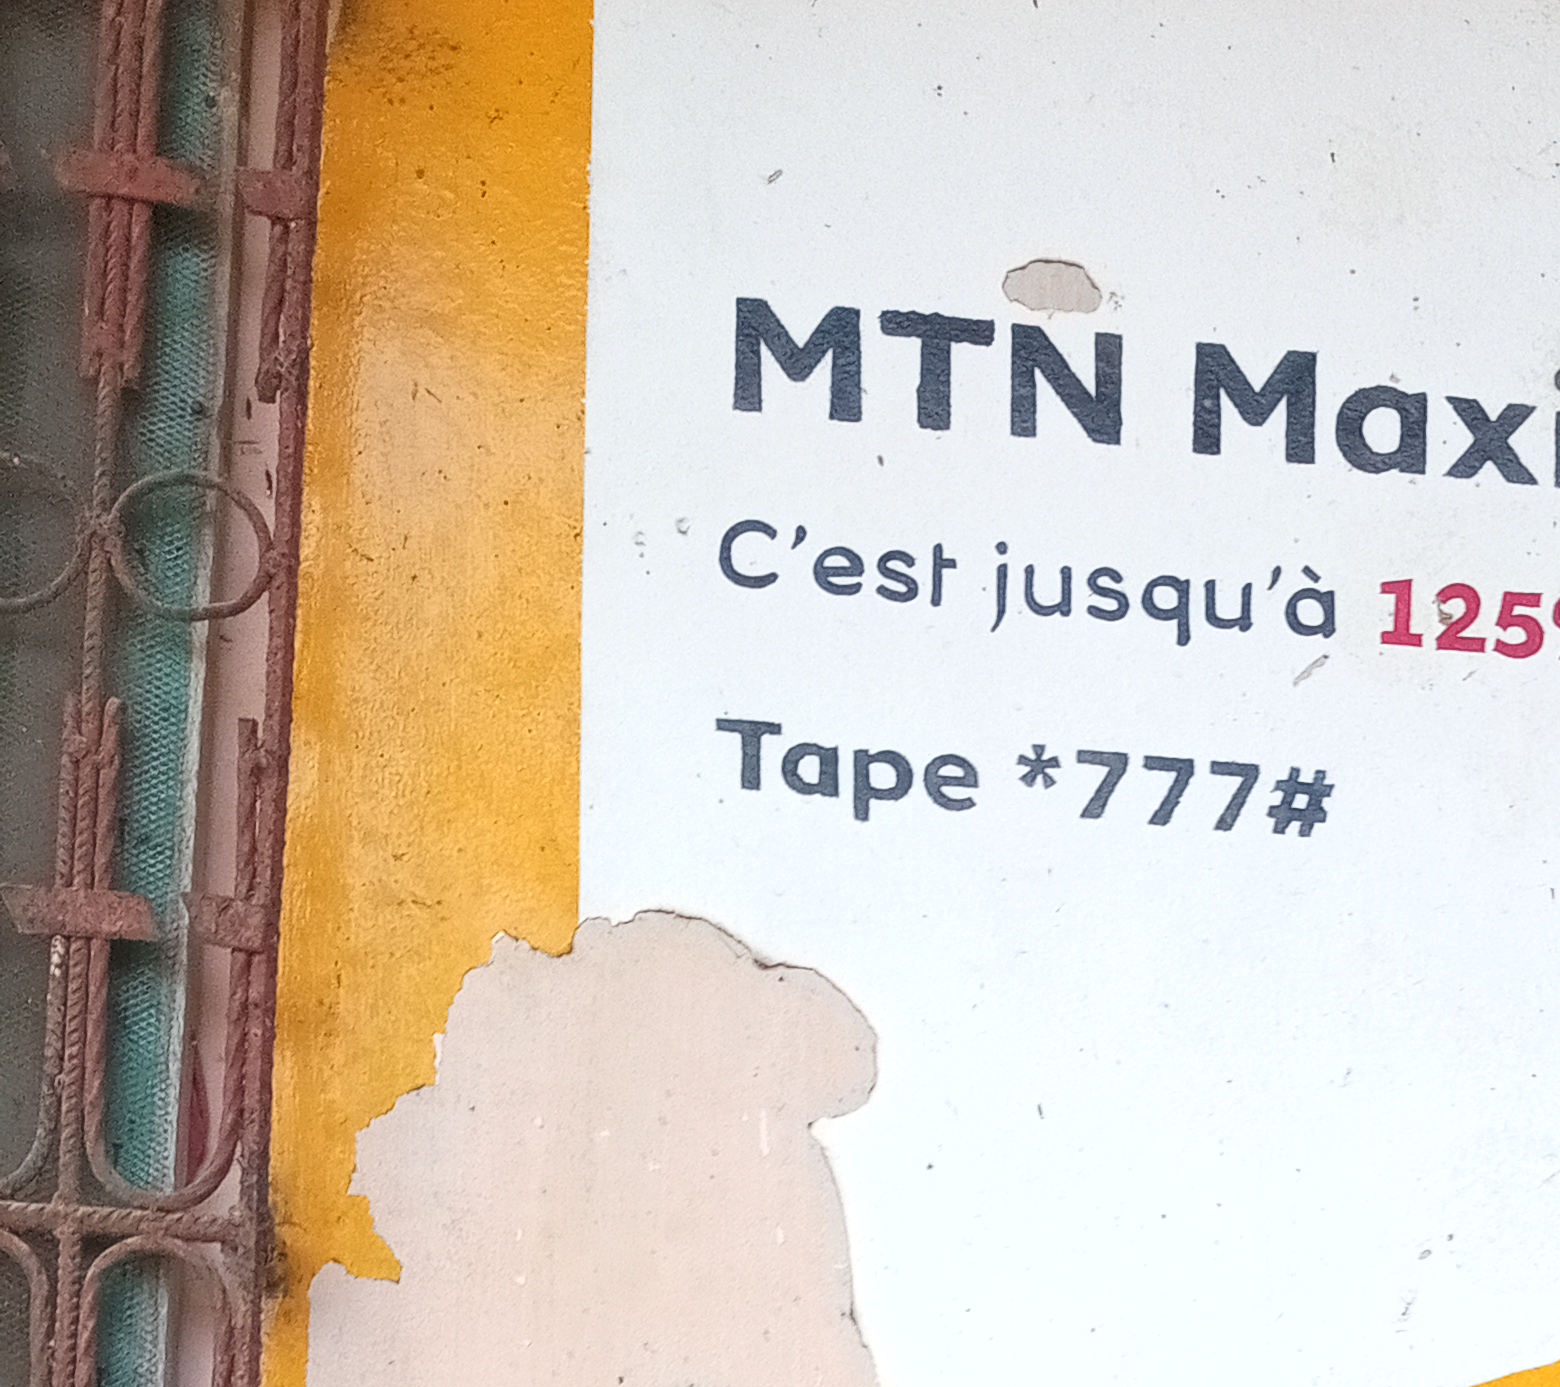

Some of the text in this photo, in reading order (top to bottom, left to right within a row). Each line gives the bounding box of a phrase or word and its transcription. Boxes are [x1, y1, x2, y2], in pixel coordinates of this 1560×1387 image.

[732, 296, 1124, 446] MTN
[717, 518, 958, 608] C'est
[990, 540, 1337, 648] jusqu'à
[715, 717, 979, 823] Tape
